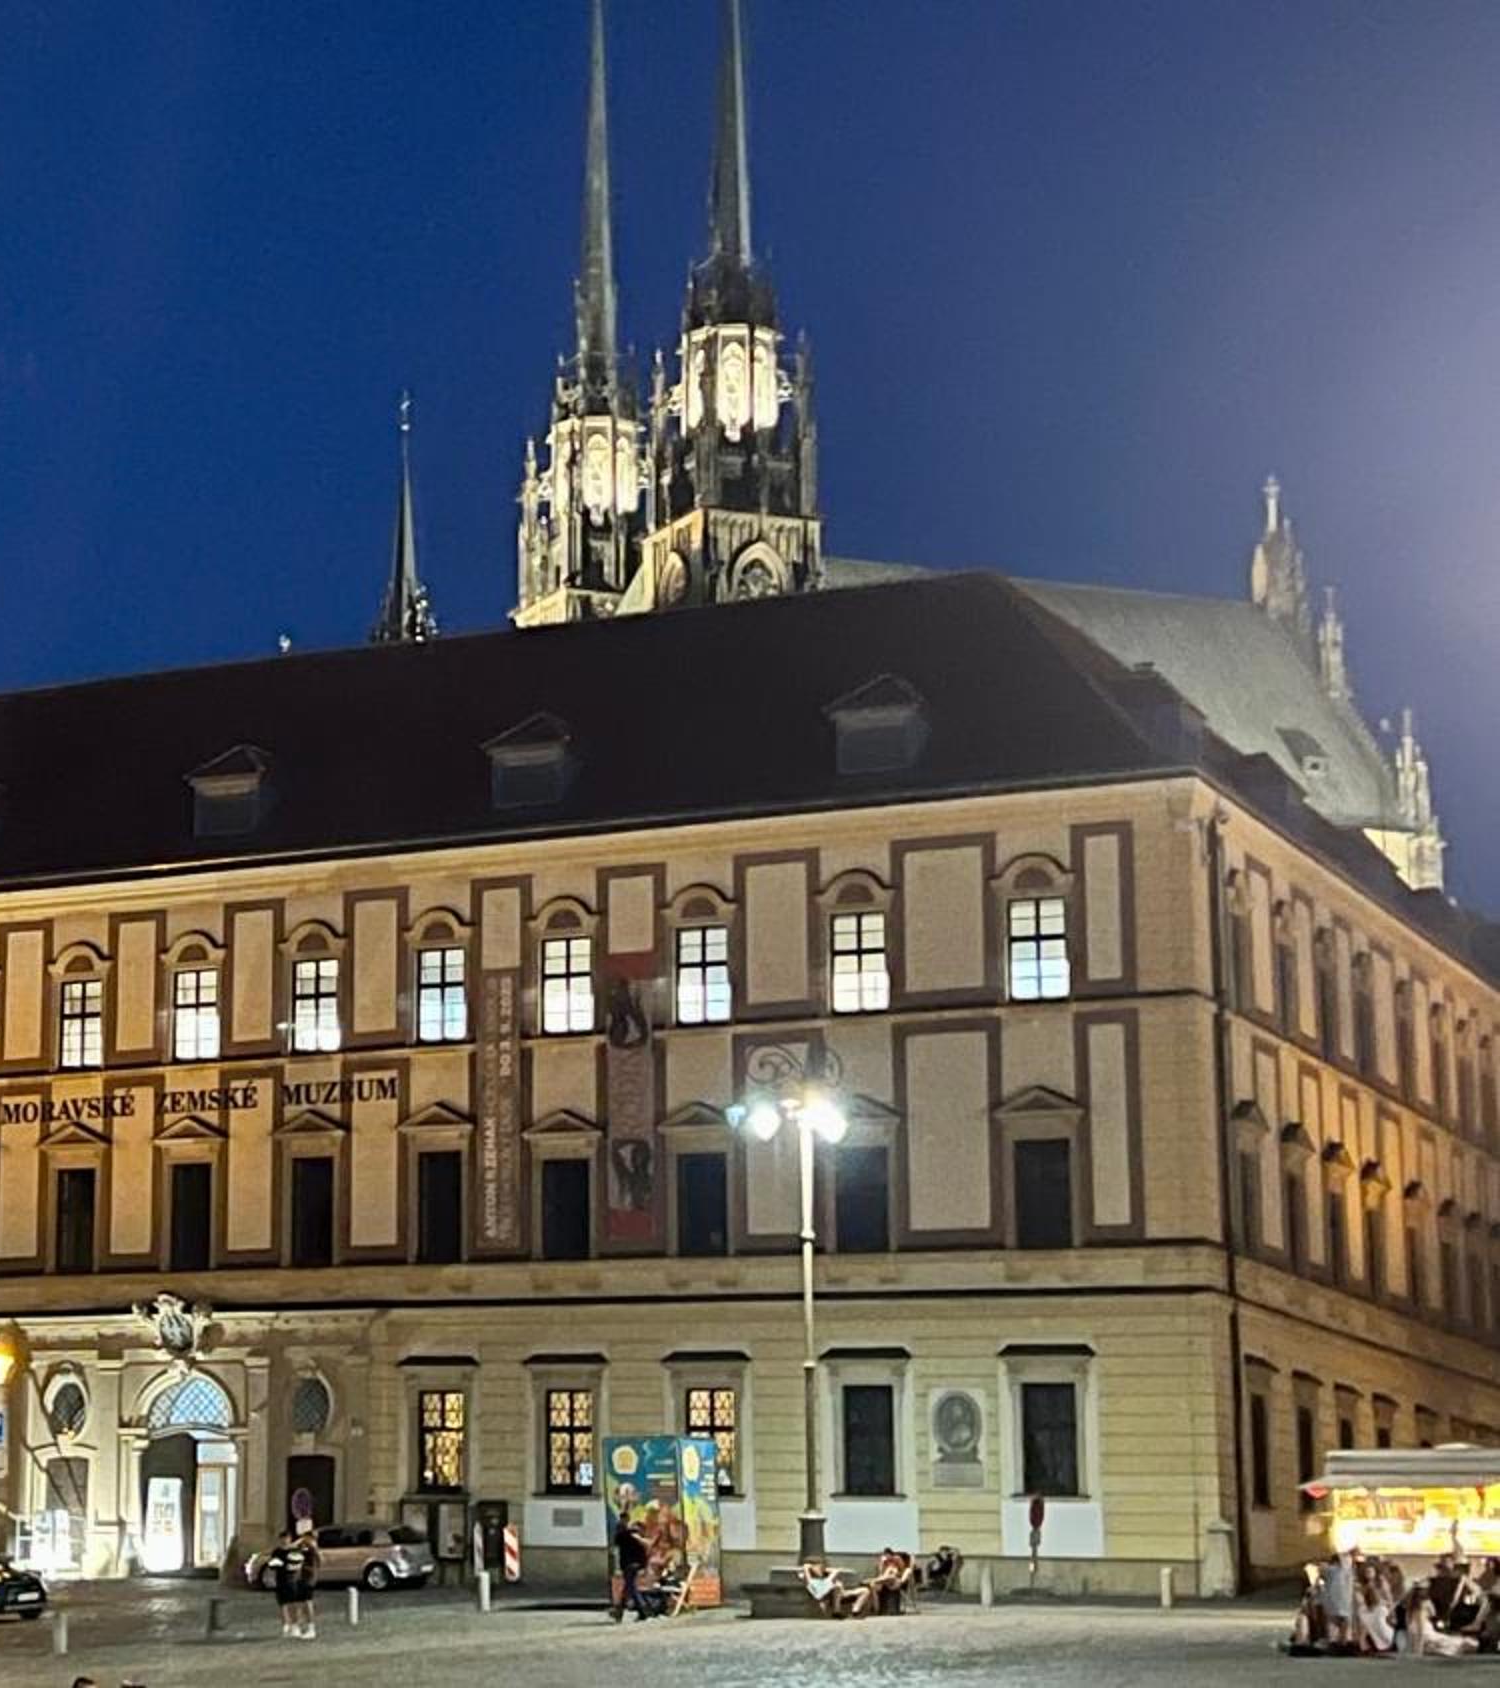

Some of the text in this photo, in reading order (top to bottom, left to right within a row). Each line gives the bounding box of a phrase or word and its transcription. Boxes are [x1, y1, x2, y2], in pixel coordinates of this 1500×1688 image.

[2, 1077, 398, 1124] MORAVSKÉ ZEMSKÉ MUZEUM
